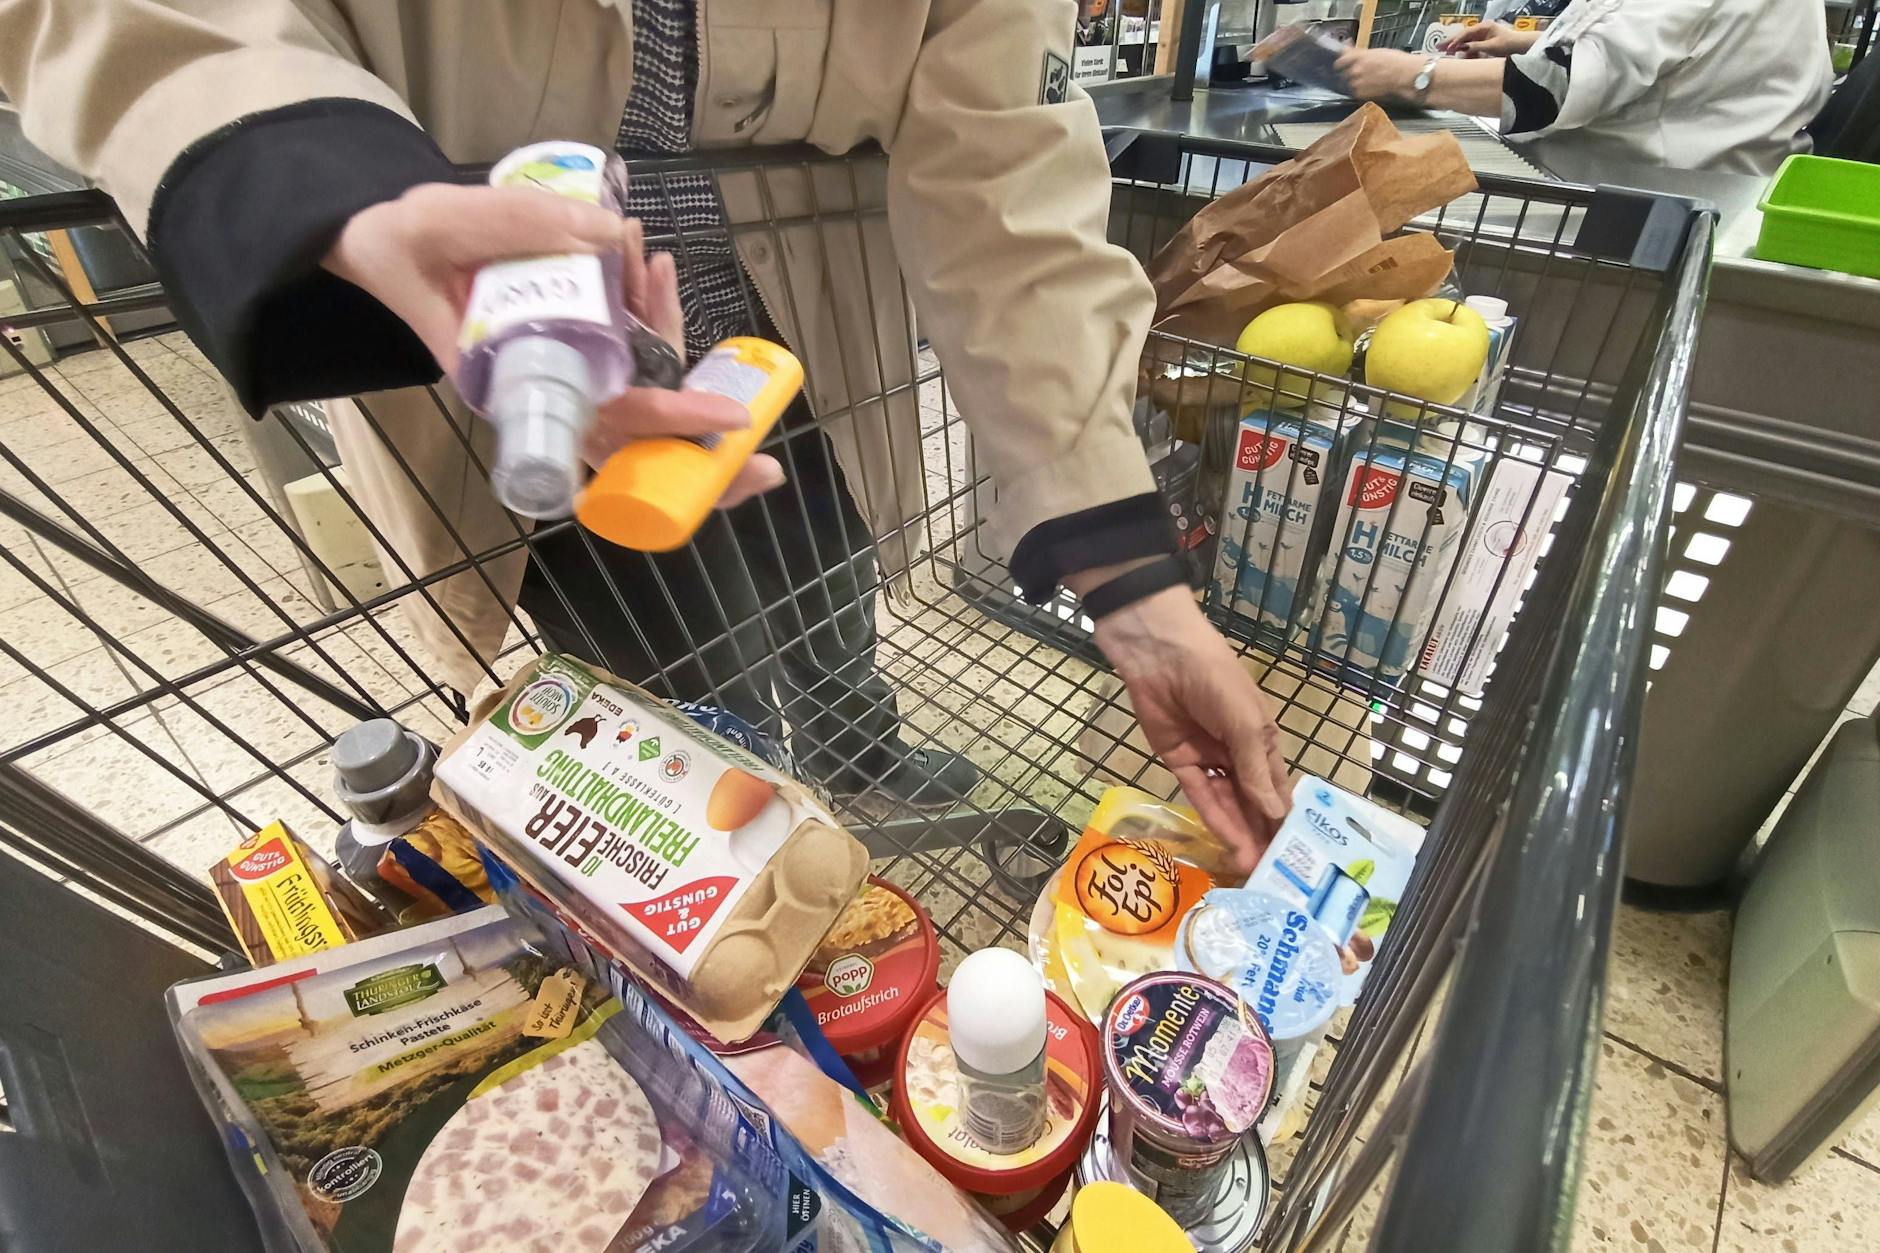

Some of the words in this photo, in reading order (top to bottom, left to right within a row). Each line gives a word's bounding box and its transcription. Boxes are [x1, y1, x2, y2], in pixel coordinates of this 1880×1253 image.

[1351, 520, 1378, 549] H
[591, 691, 624, 717] EDEKA
[529, 782, 550, 802] AUS
[619, 773, 673, 808] GÜTEKLASSE
[536, 750, 701, 868] FREILANDHALTUNG
[1305, 808, 1349, 846] elkos
[525, 794, 608, 868] EIER
[580, 855, 603, 877] 10
[597, 831, 669, 890] FRISCHE
[643, 886, 718, 916] GÜNSTIG
[1087, 852, 1128, 916] Fol
[1121, 863, 1163, 923] Epi
[666, 916, 702, 936] GUT
[677, 906, 690, 919] &
[832, 966, 868, 988] popp
[817, 986, 900, 1026] Brotaufstrich
[349, 998, 482, 1054] Schinken-Frischkäse
[400, 1022, 452, 1046] Pastete
[1125, 984, 1201, 1086] Momente
[377, 1020, 497, 1074] Metzger-Qualität
[1161, 1044, 1191, 1089] MOUSSE
[1182, 1007, 1212, 1050] ROTWEIN
[316, 1154, 374, 1192] kontrolliert
[791, 1193, 801, 1215] HIER
[801, 1188, 812, 1222] ÖFFNEN
